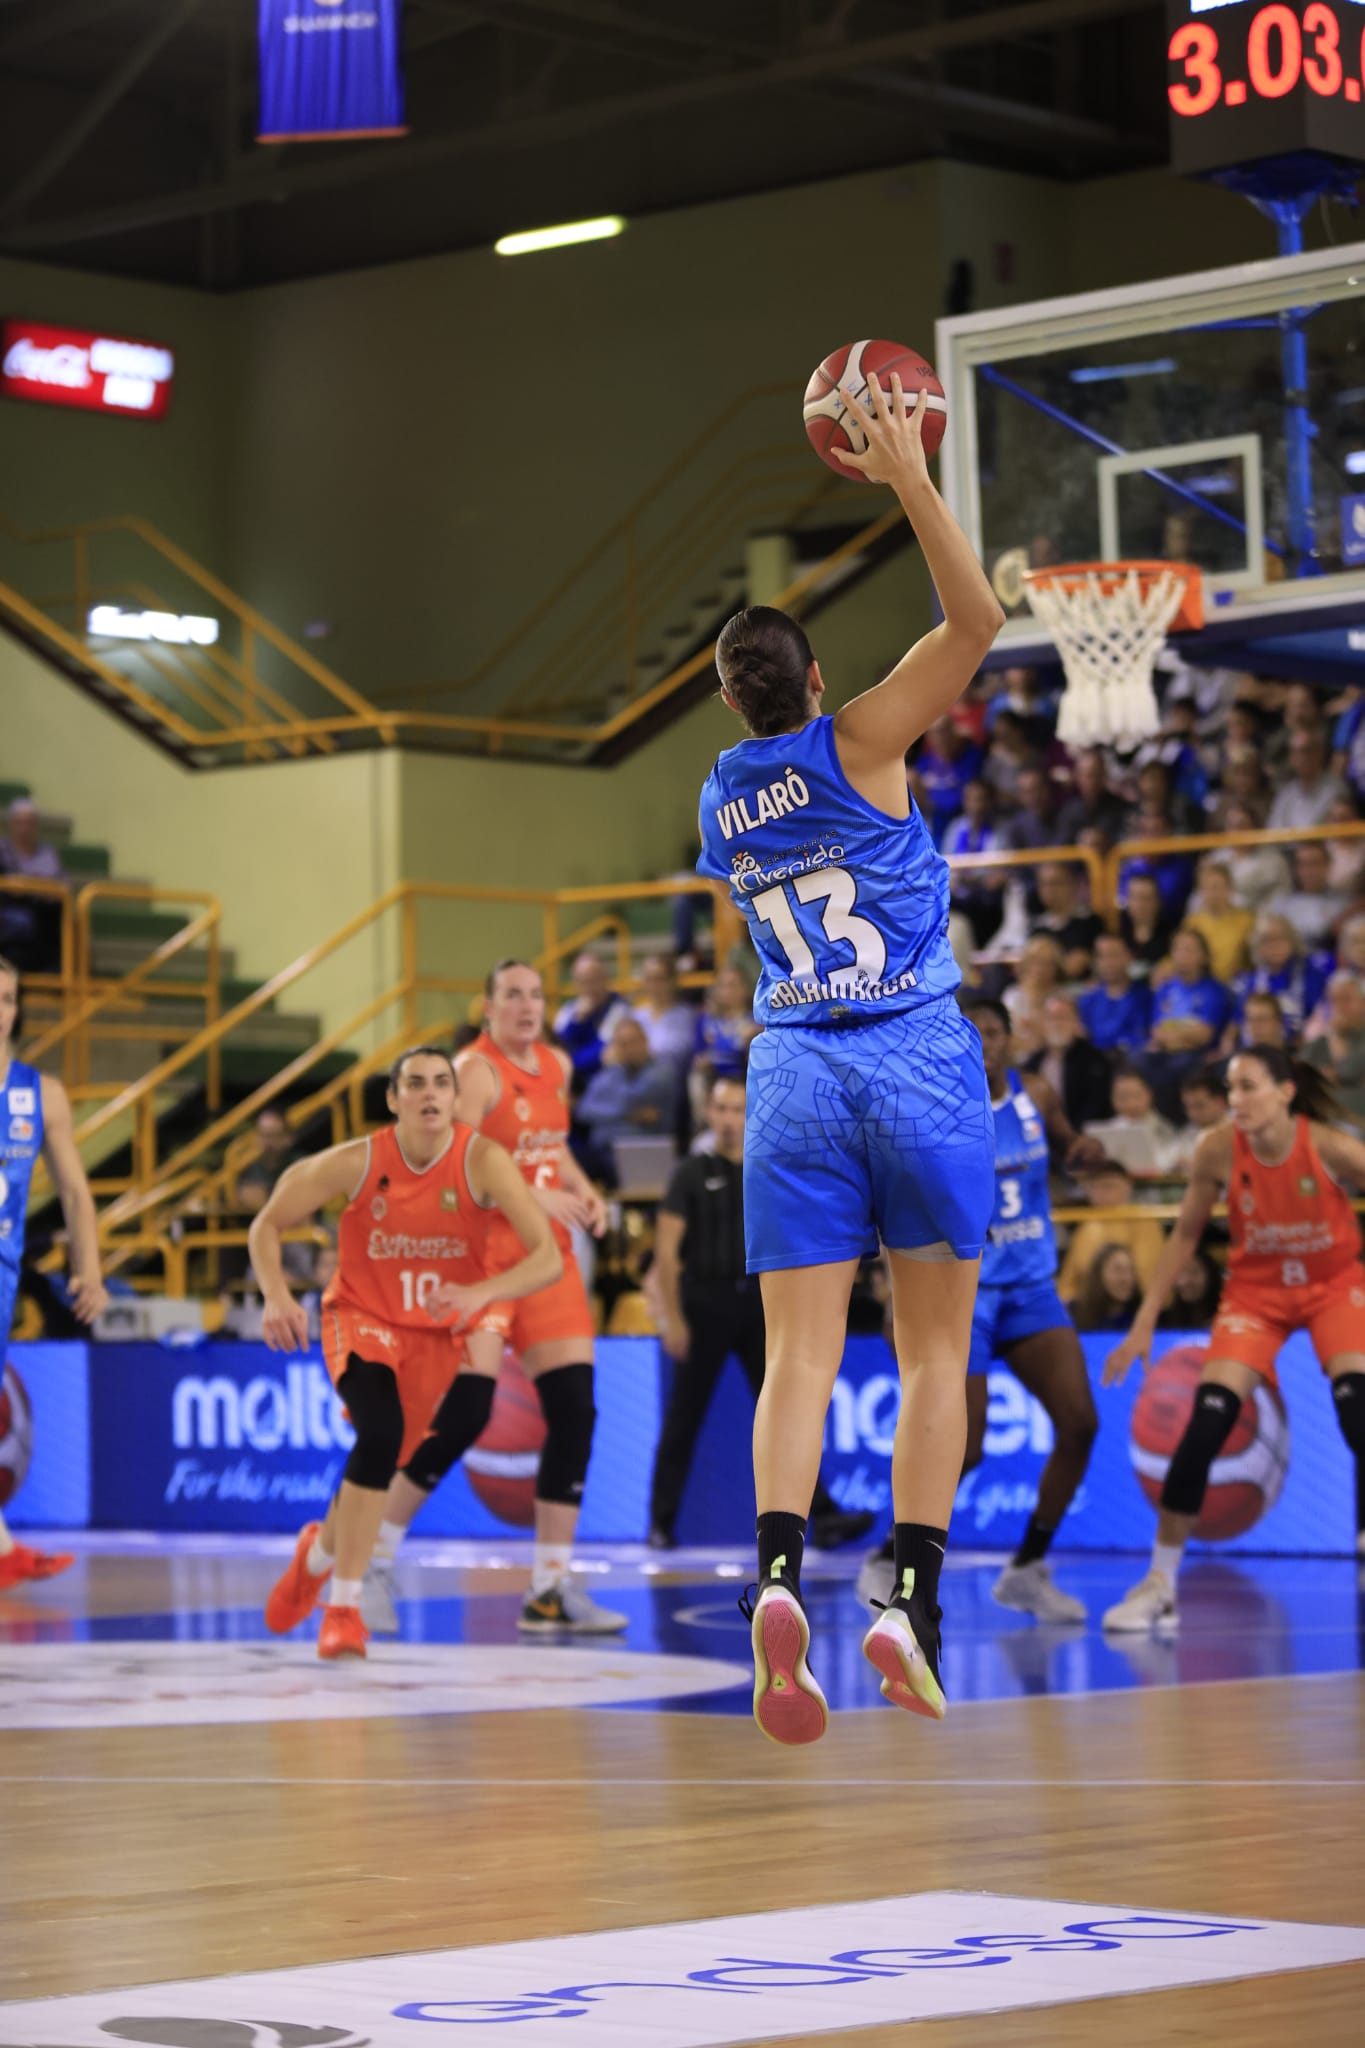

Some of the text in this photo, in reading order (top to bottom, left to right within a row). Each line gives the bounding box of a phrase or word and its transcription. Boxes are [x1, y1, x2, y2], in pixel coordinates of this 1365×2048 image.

[1303, 2, 1365, 102] 3.
[716, 766, 810, 841] VILARÓ
[751, 865, 888, 988] 13
[1000, 1179, 1022, 1219] 3
[399, 1270, 441, 1312] 10
[390, 1916, 1268, 2024] endesa
